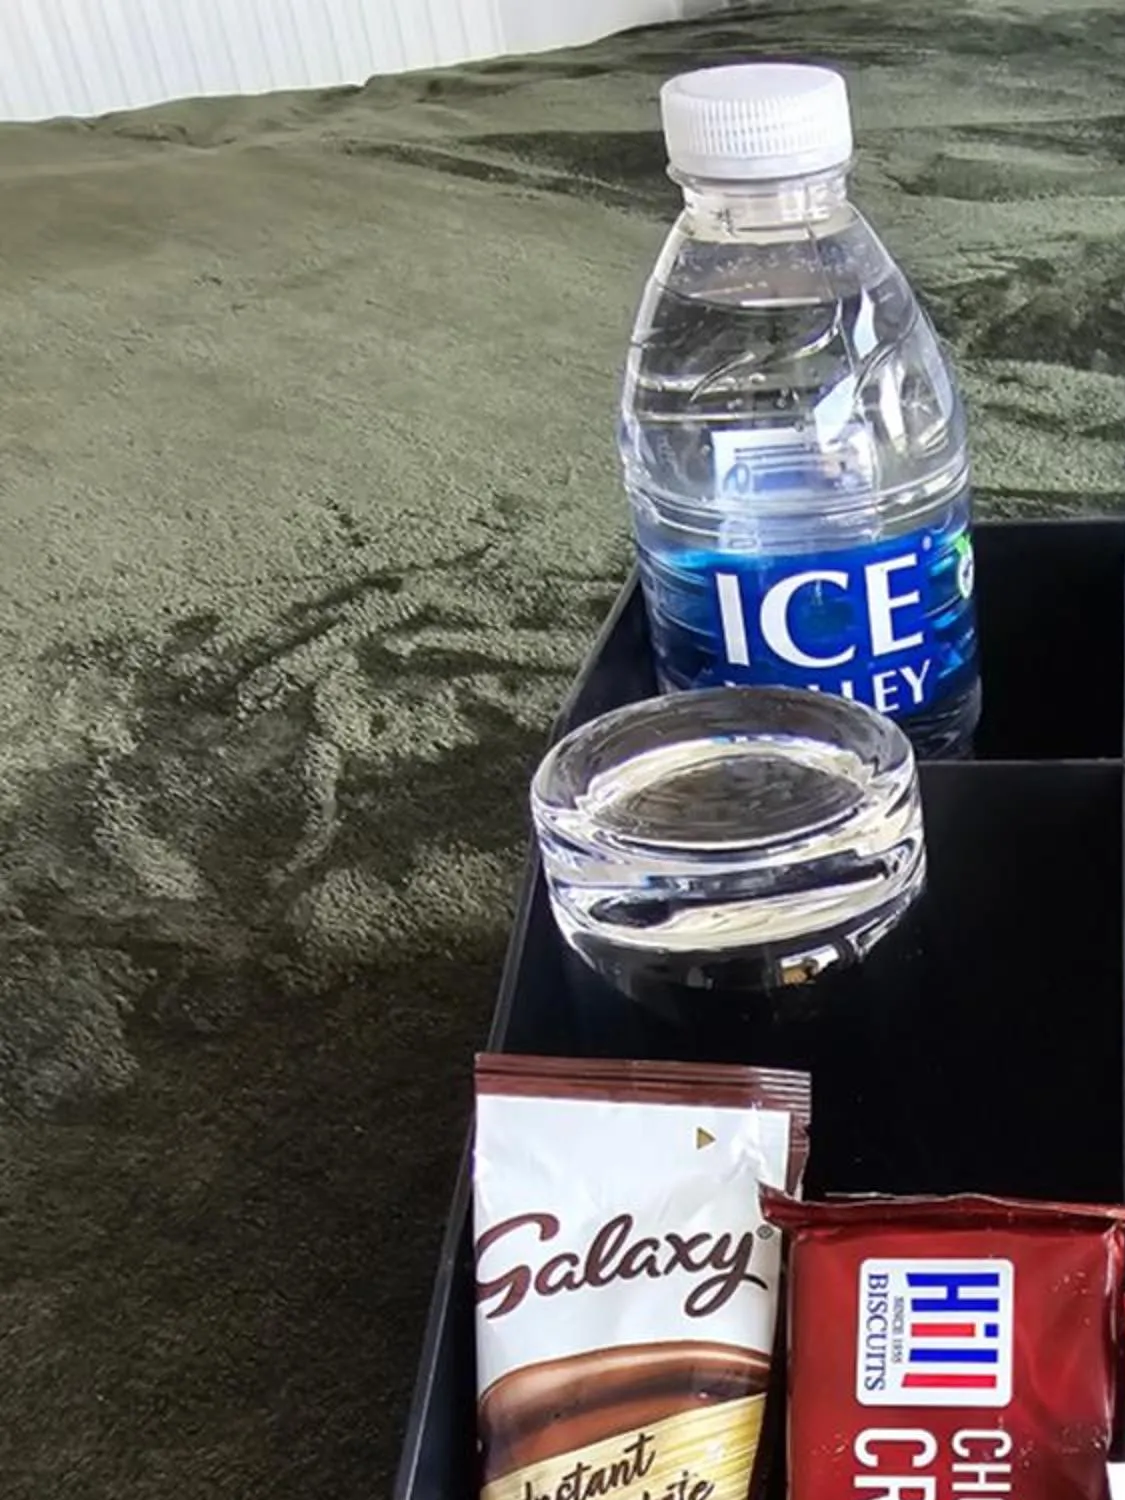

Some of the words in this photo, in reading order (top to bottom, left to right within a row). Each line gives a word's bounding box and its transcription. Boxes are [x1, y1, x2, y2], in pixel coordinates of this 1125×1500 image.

[714, 552, 924, 669] ICE
[476, 1212, 768, 1319] Galaxy
[863, 1272, 890, 1392] BISCUITS
[900, 1272, 1001, 1389] Hill
